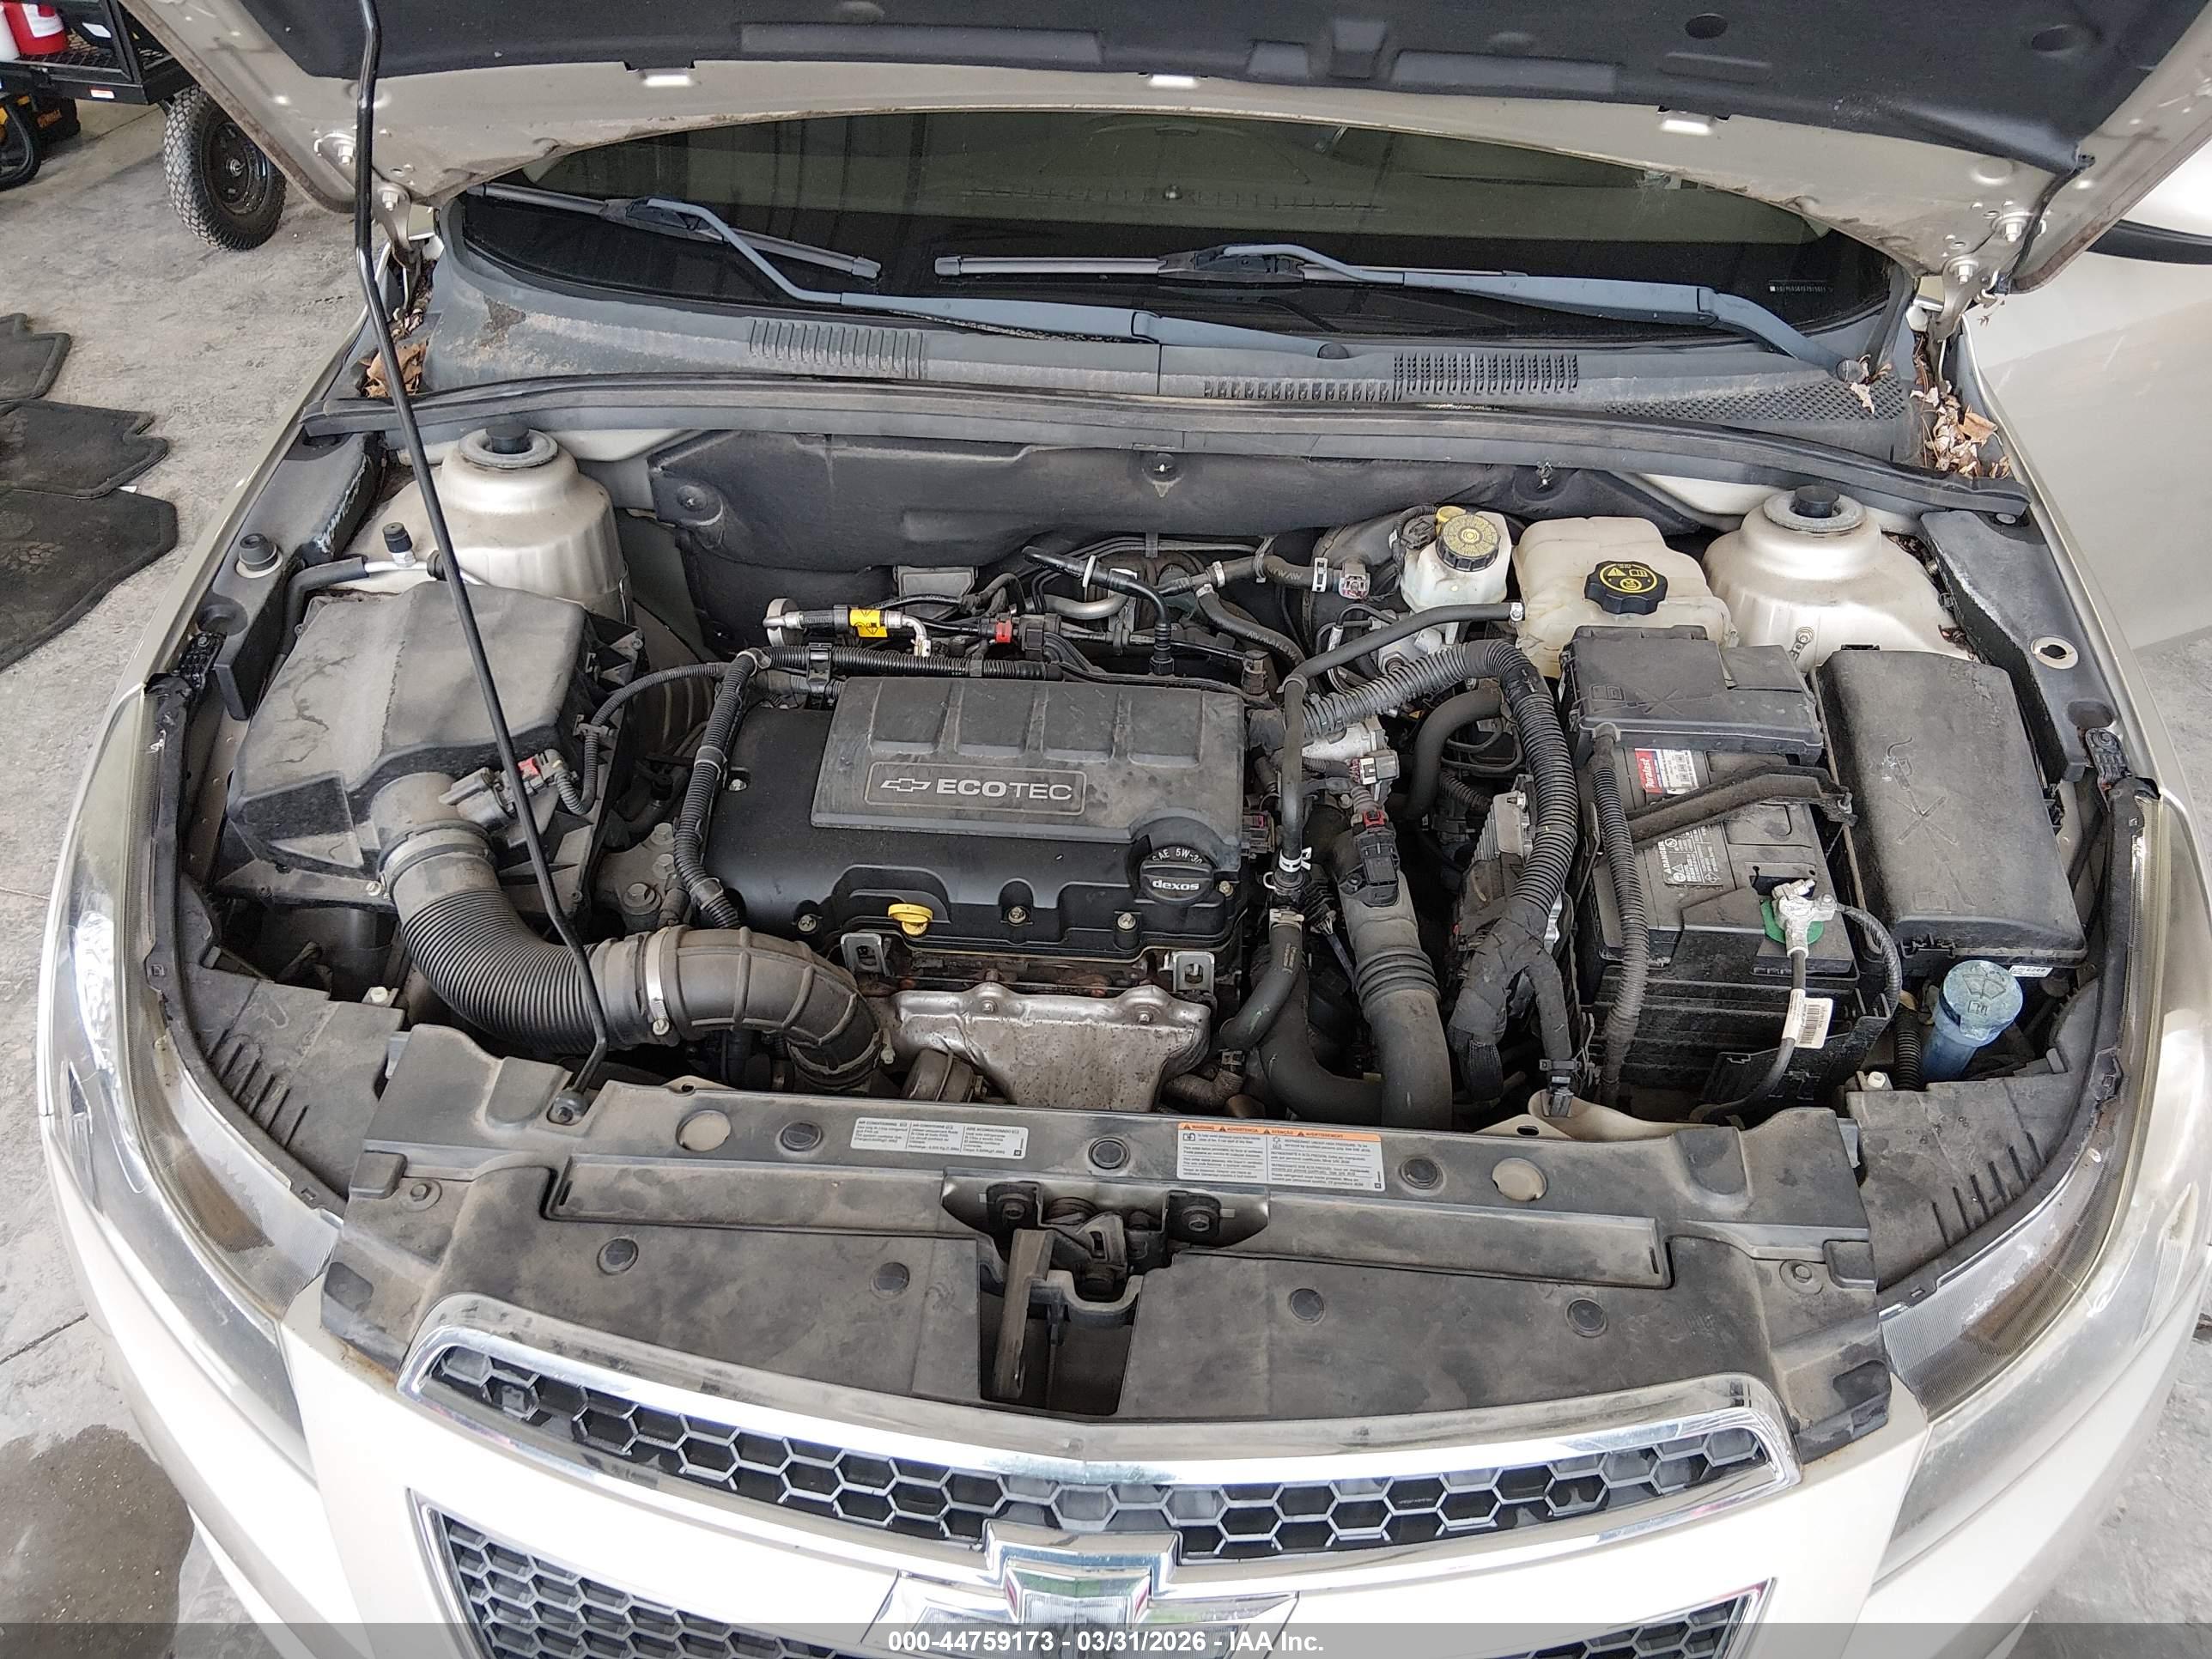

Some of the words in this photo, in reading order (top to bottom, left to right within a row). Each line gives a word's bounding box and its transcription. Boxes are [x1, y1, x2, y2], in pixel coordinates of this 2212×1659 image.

[936, 777, 1073, 800] ECOTEC
[1152, 848, 1170, 862] SAE
[1175, 848, 1203, 864] 5W-30
[1657, 840, 1670, 868] DANGER
[1152, 878, 1200, 891] dexos
